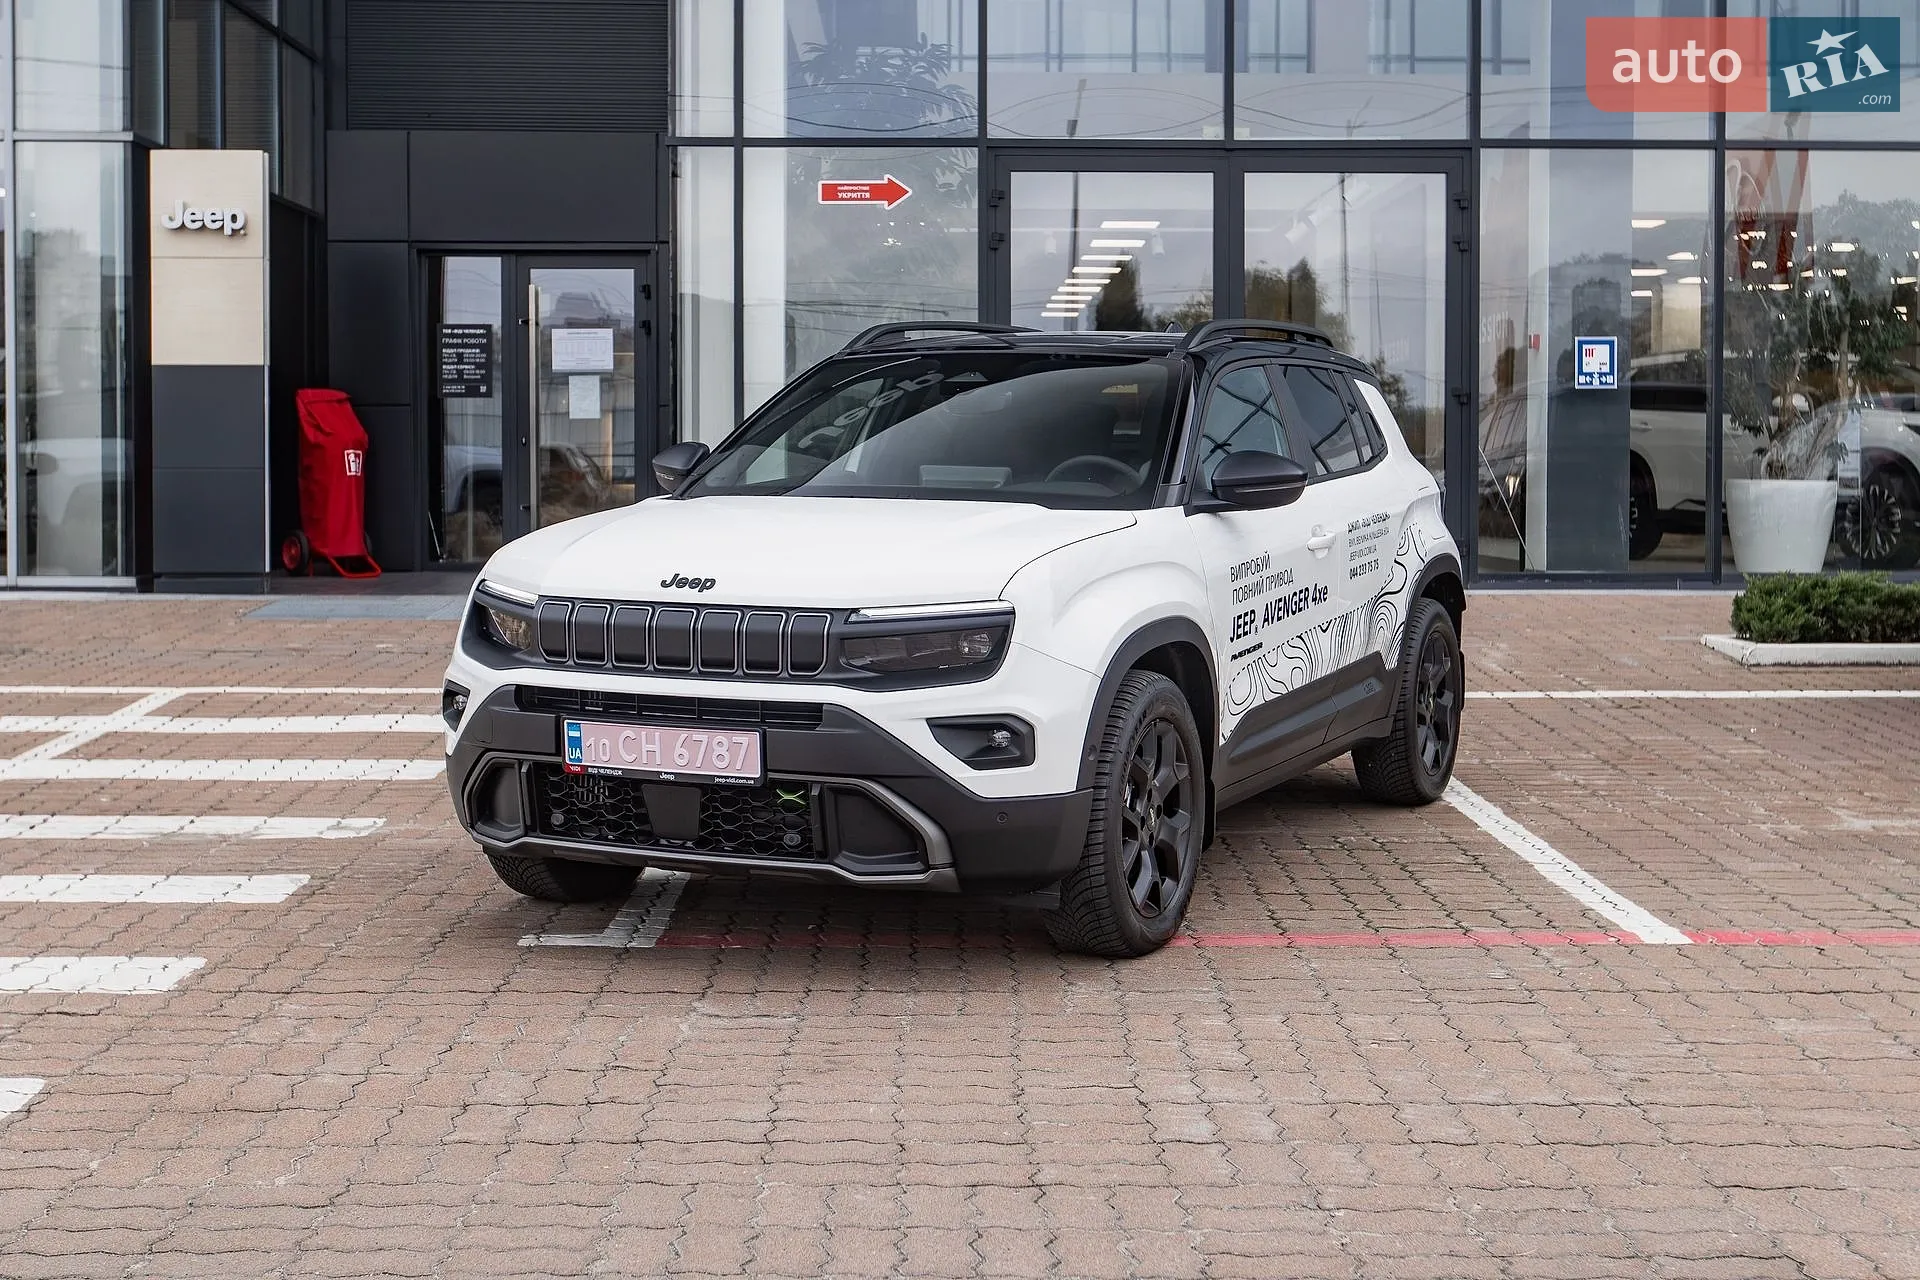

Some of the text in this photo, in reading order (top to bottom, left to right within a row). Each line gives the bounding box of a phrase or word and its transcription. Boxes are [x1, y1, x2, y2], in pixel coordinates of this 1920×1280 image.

[161, 199, 245, 236] Jeep
[660, 573, 717, 593] Jeep
[1230, 550, 1271, 583] ВИПРОБУЙ
[1349, 557, 1379, 580] 044 233 75 75
[1232, 567, 1294, 606] ПОВНИЙ ПРИВОД
[1261, 586, 1310, 629] AVENGER
[1311, 583, 1328, 606] 4xe
[568, 729, 750, 770] UA 10 CH 6787
[659, 772, 675, 781] Jeep
